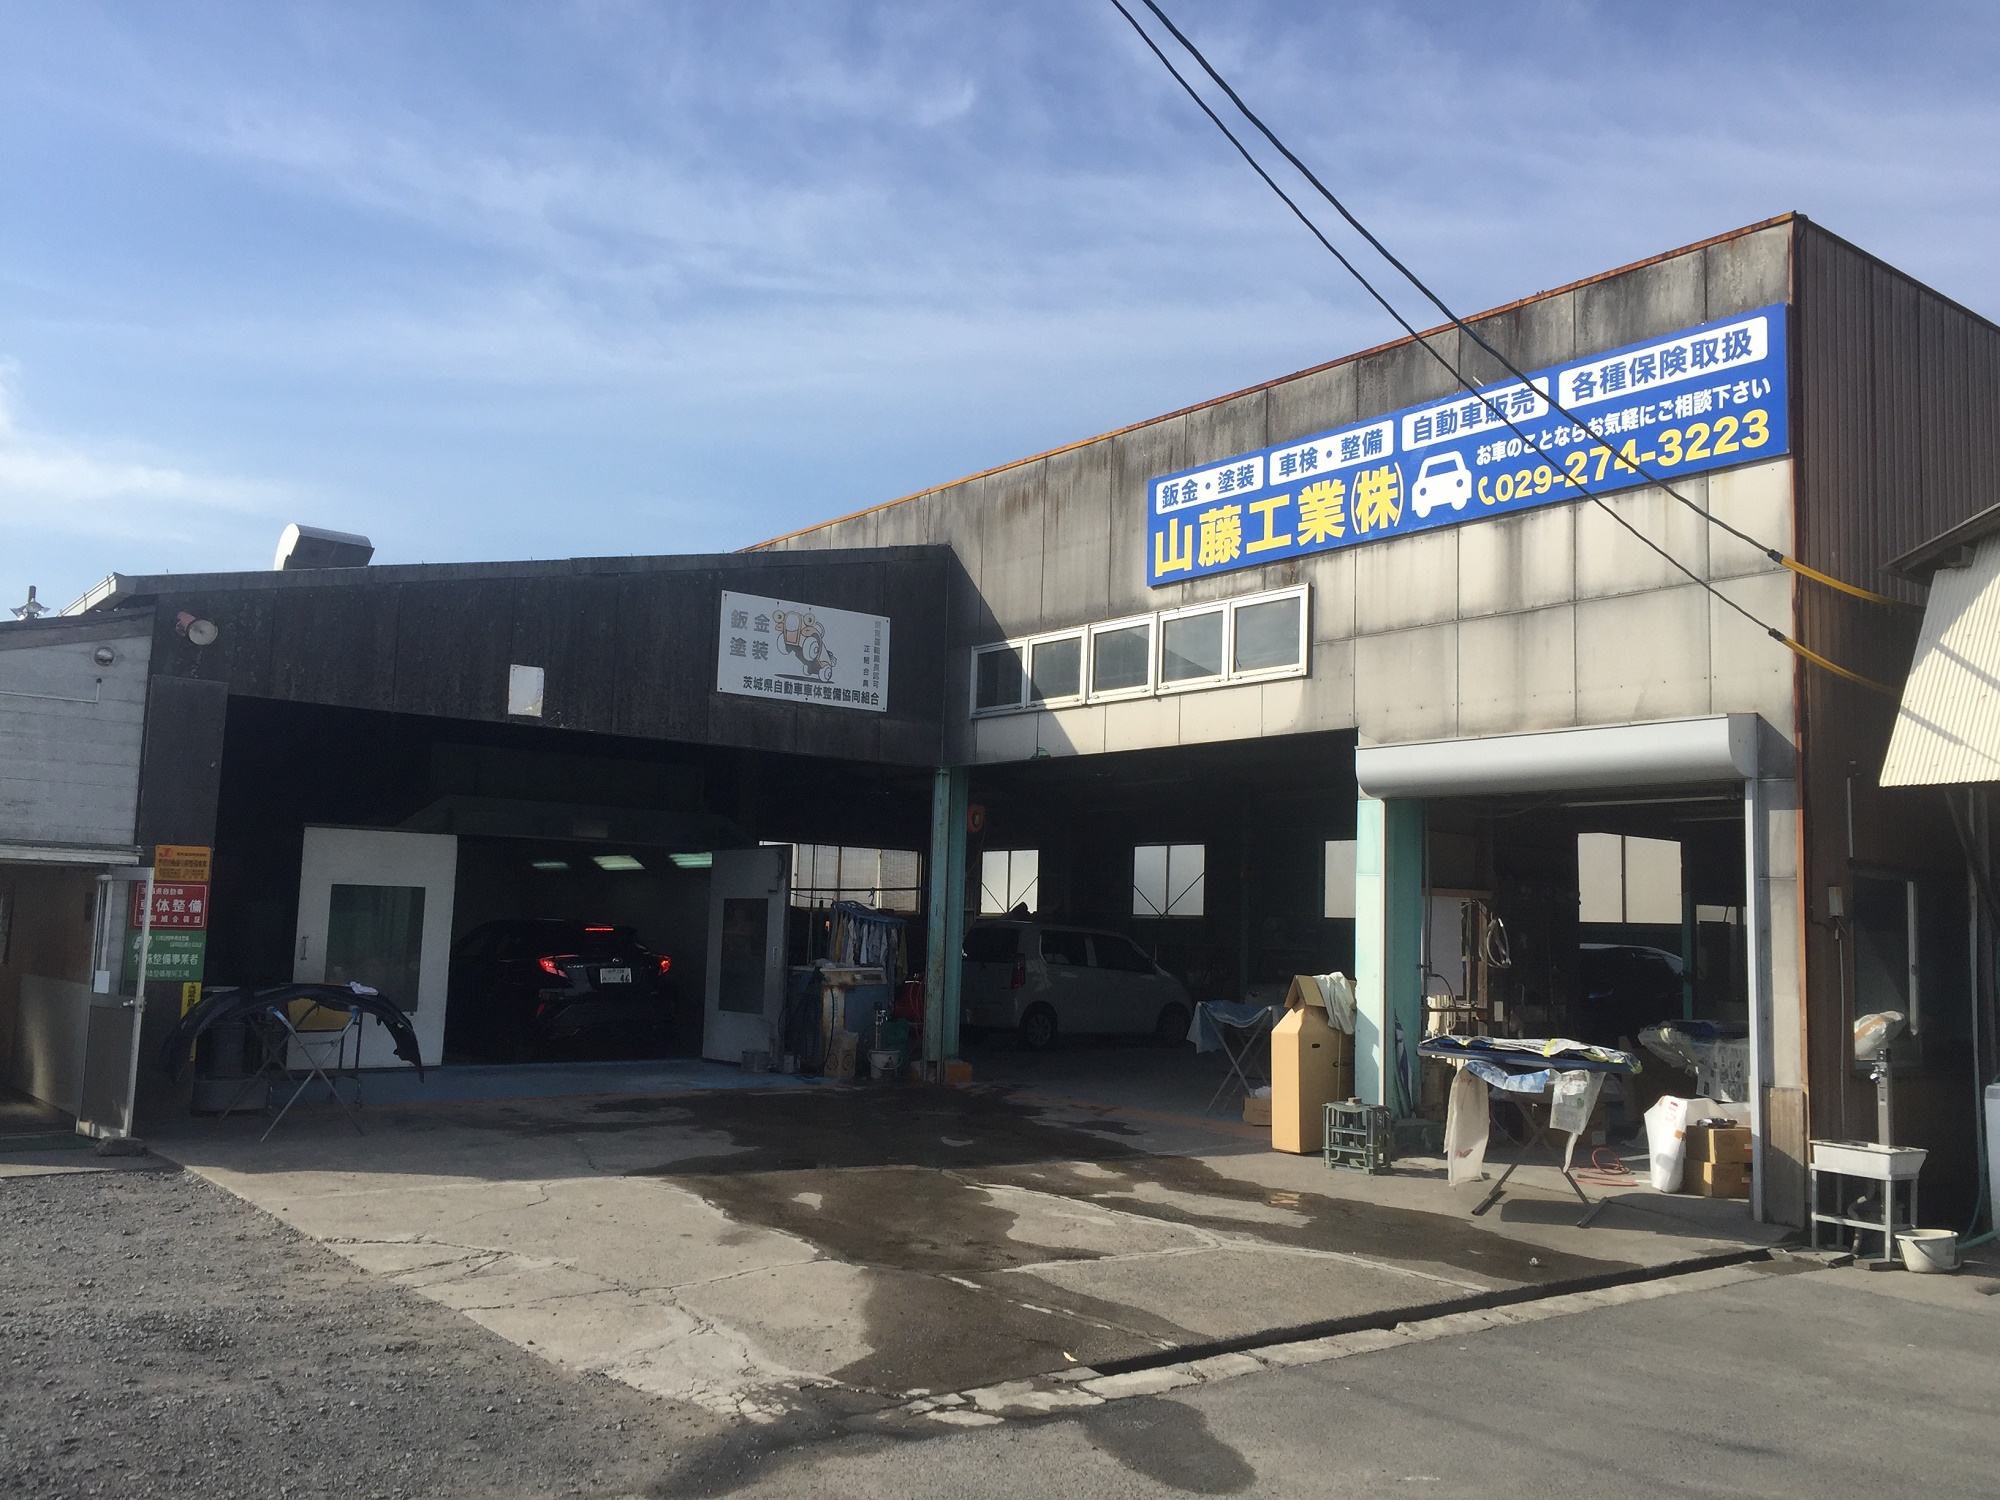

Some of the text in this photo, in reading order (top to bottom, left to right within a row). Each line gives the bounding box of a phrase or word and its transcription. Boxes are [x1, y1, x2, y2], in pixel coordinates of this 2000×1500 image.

[1571, 327, 1752, 401] 各種保険取扱
[1413, 388, 1535, 444] 自動車販売
[1476, 377, 1771, 465] お車のことならお気軽にご相談下さい
[1279, 428, 1383, 478] 車検・整備
[1495, 408, 1770, 502] 029-274-3223
[1162, 464, 1255, 509] 鈑金・塗装
[731, 609, 770, 634] 鈑金
[729, 636, 770, 662] 塗装
[743, 675, 880, 706] 茨城県自動車車体整備協同組合
